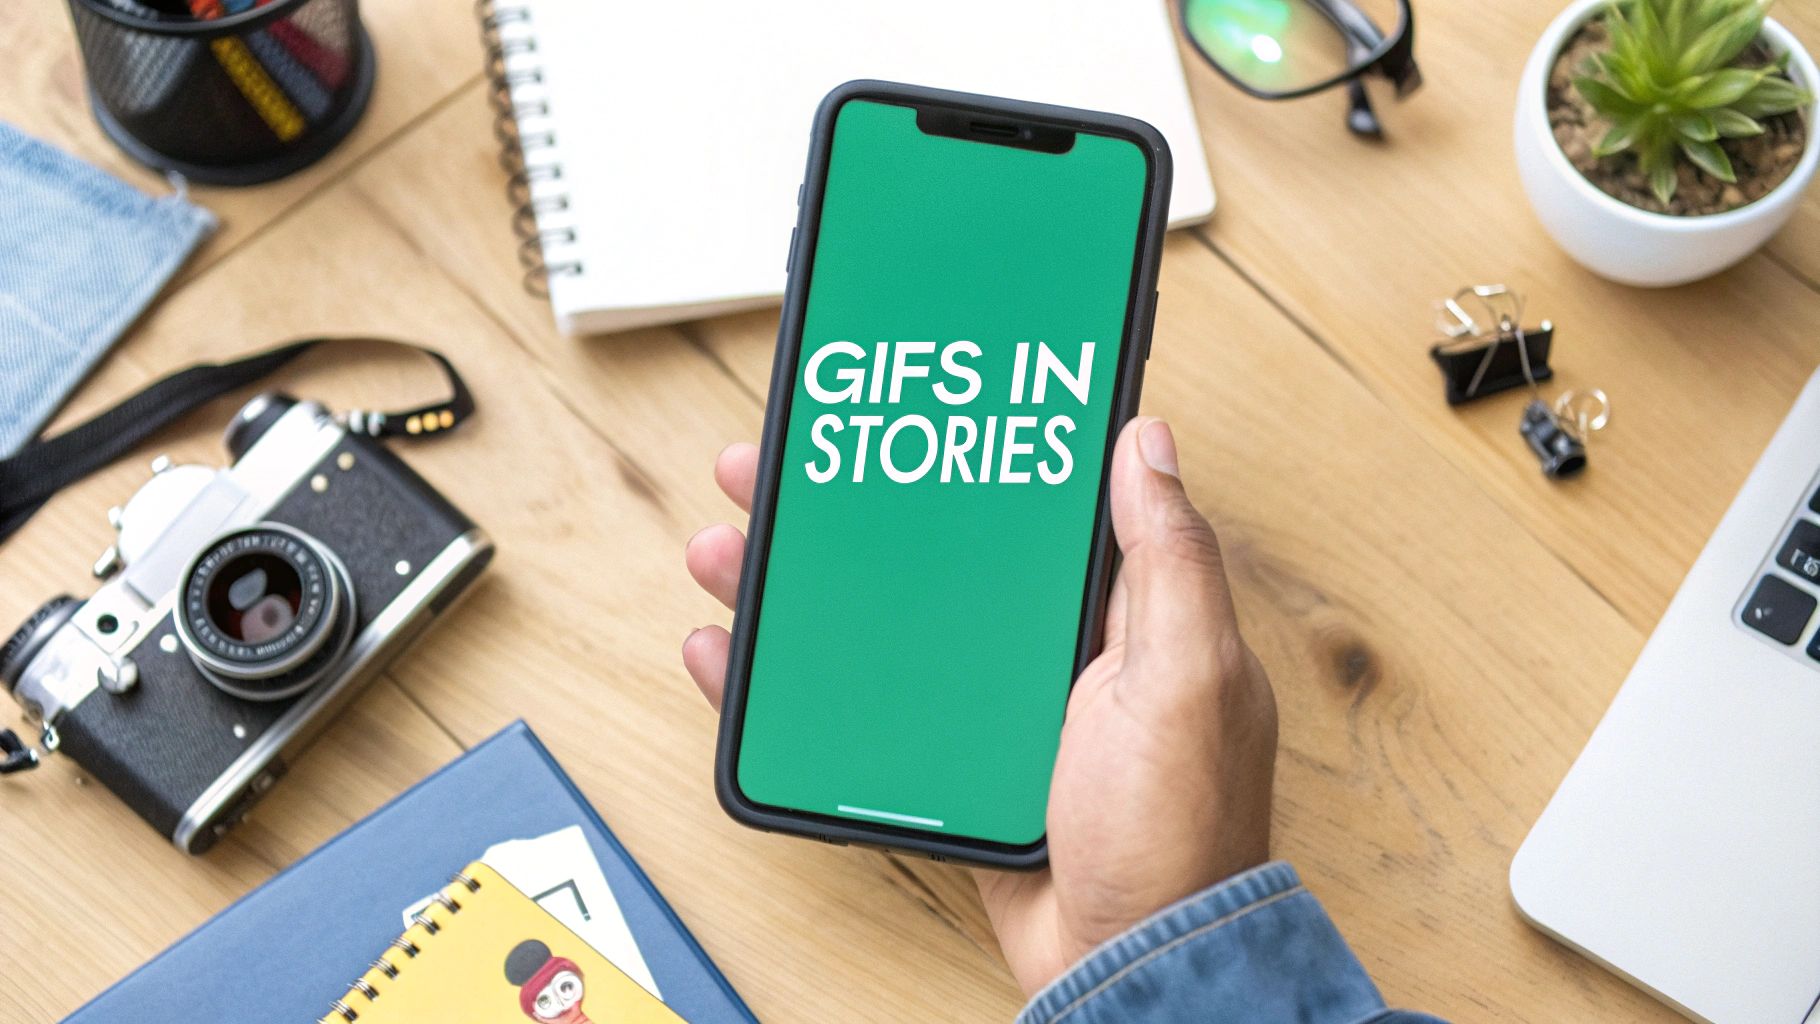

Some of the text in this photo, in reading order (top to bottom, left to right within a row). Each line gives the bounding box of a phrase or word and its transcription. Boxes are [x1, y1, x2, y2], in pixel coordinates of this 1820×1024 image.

[804, 341, 1095, 405] GIFS IN
[805, 414, 1076, 484] STORIES
